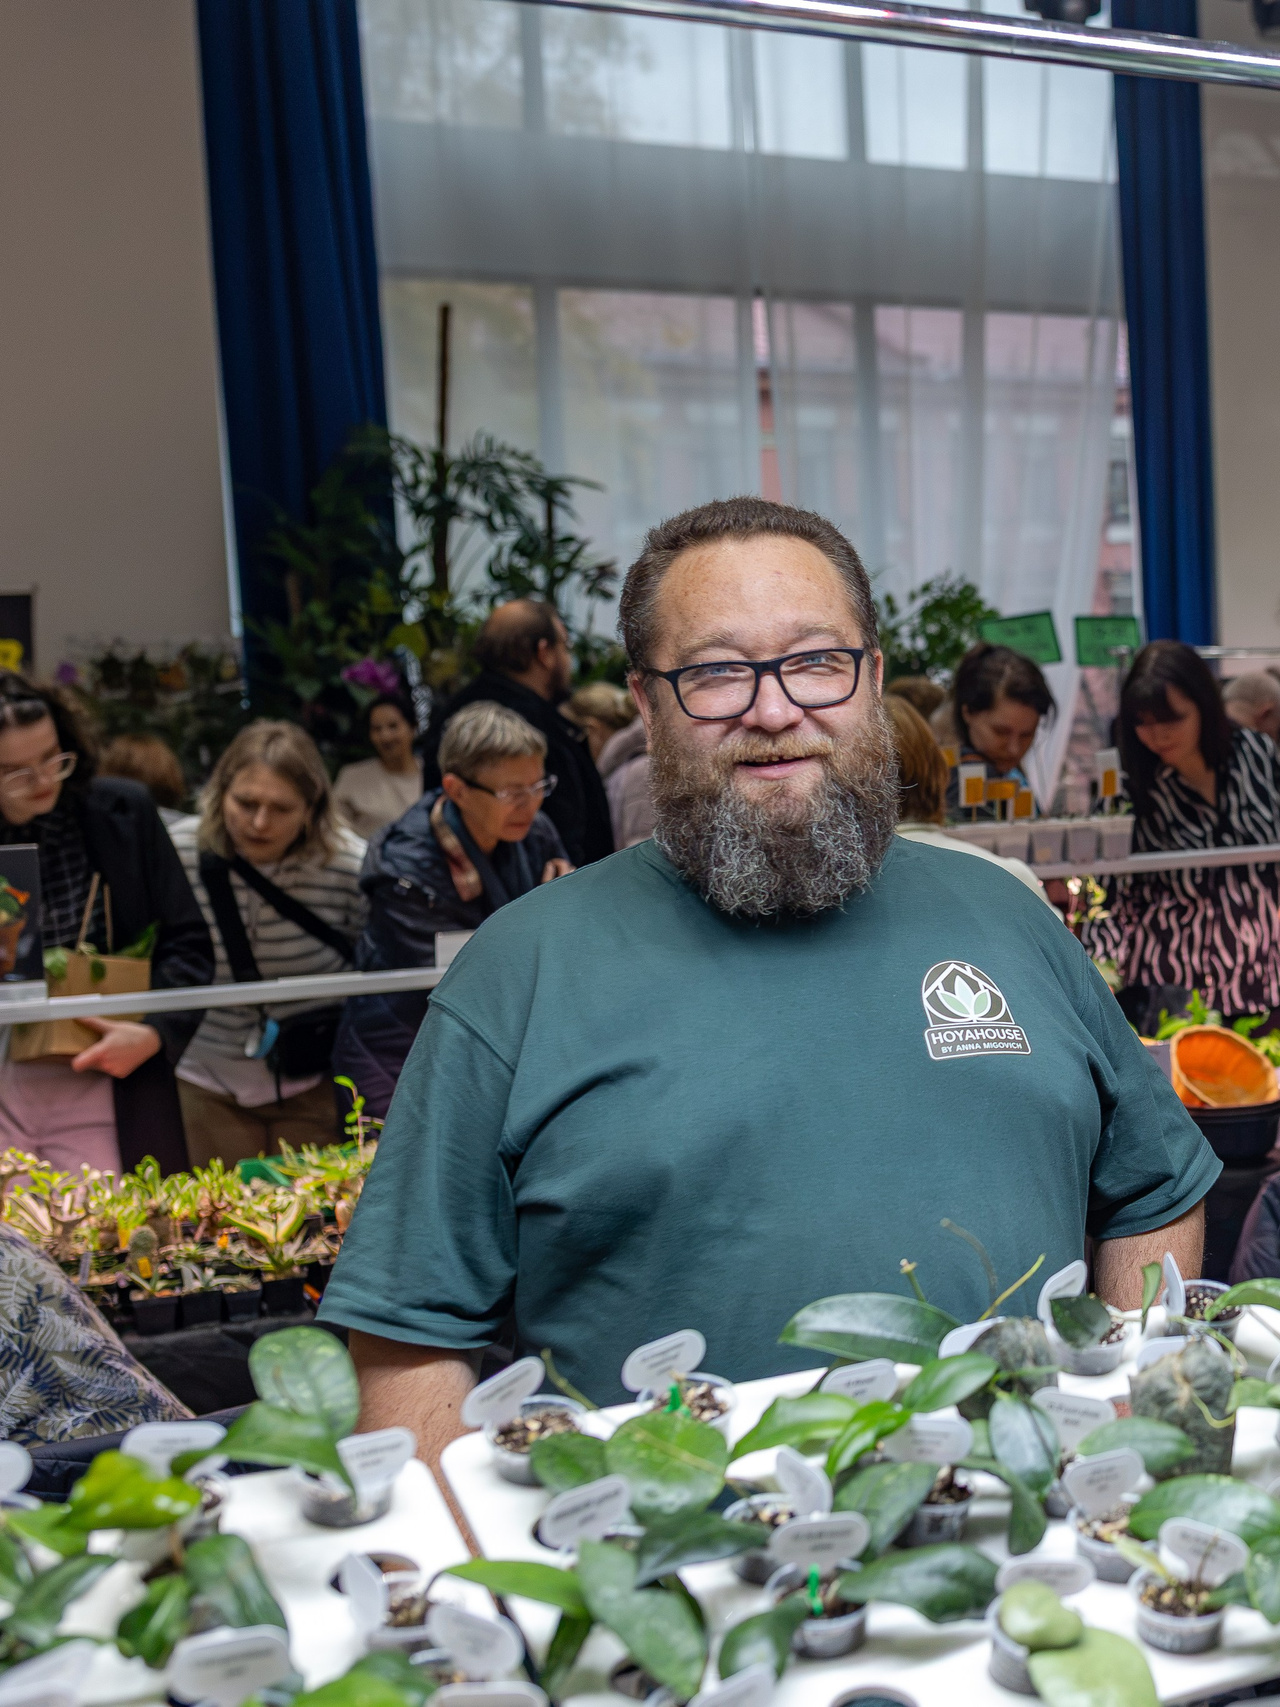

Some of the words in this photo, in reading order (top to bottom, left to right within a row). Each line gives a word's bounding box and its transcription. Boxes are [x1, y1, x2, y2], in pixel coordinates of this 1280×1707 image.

[931, 1028, 1023, 1045] HOYAHOUSE
[941, 1045, 953, 1054] BY
[955, 1043, 981, 1052] ANNA
[983, 1041, 1022, 1050] MIGOVICH
